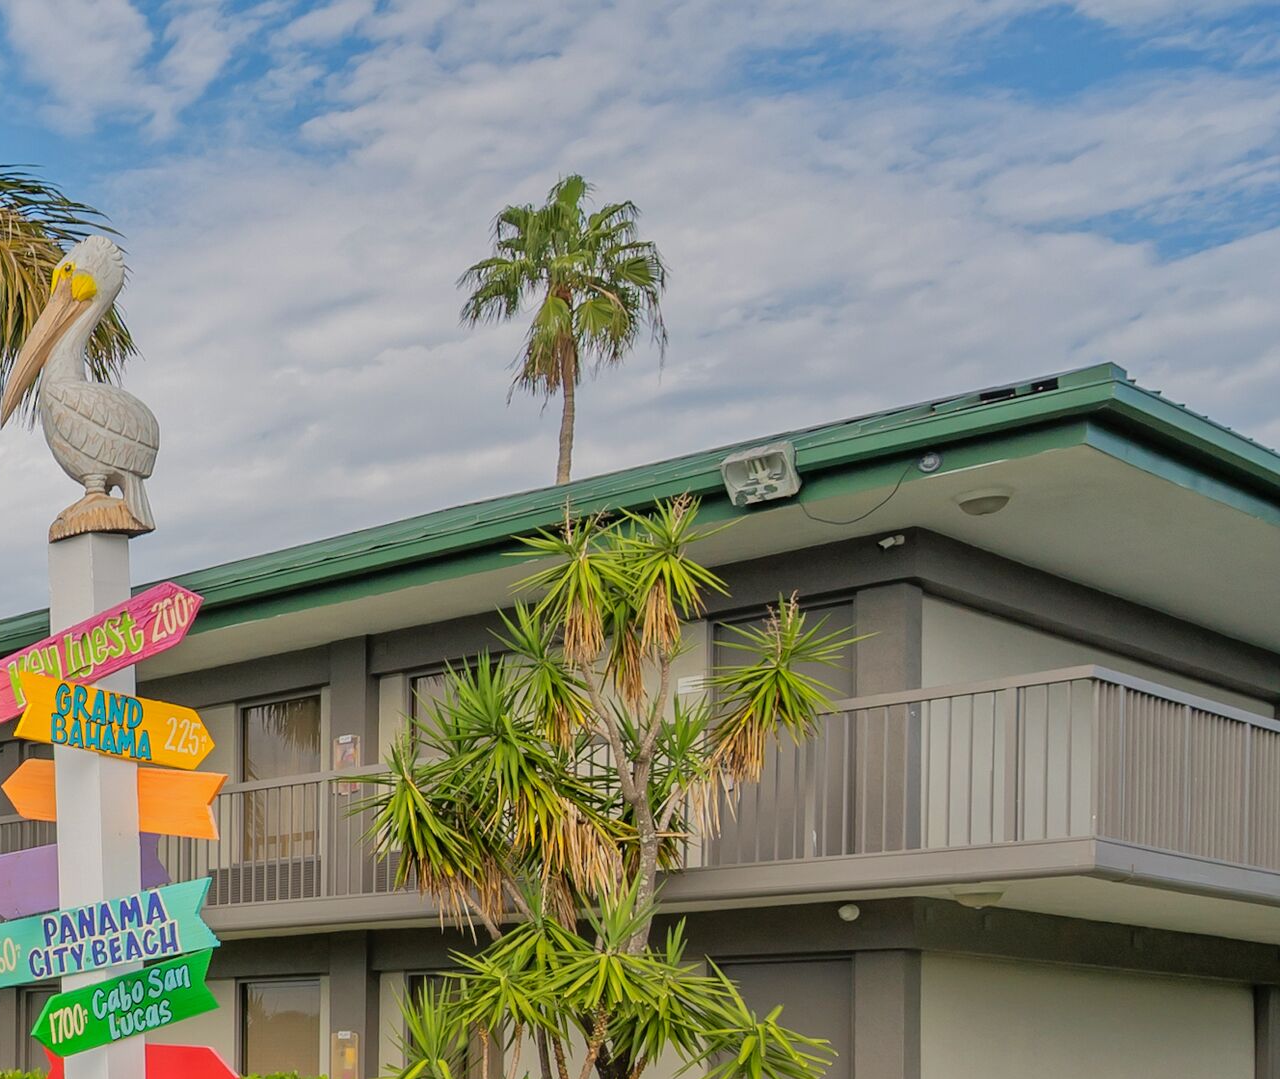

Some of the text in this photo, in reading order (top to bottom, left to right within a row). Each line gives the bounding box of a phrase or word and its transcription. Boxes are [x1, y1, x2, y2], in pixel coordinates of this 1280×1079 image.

[63, 609, 145, 678] West
[151, 592, 188, 644] 200
[55, 683, 144, 729] GRAND
[51, 712, 201, 761] BAHAMA 225
[42, 890, 169, 947] PANAMA
[27, 942, 87, 979] CITY
[89, 919, 181, 968] BEACH
[91, 963, 192, 1021] Cabo San
[48, 1003, 85, 1045] 1700
